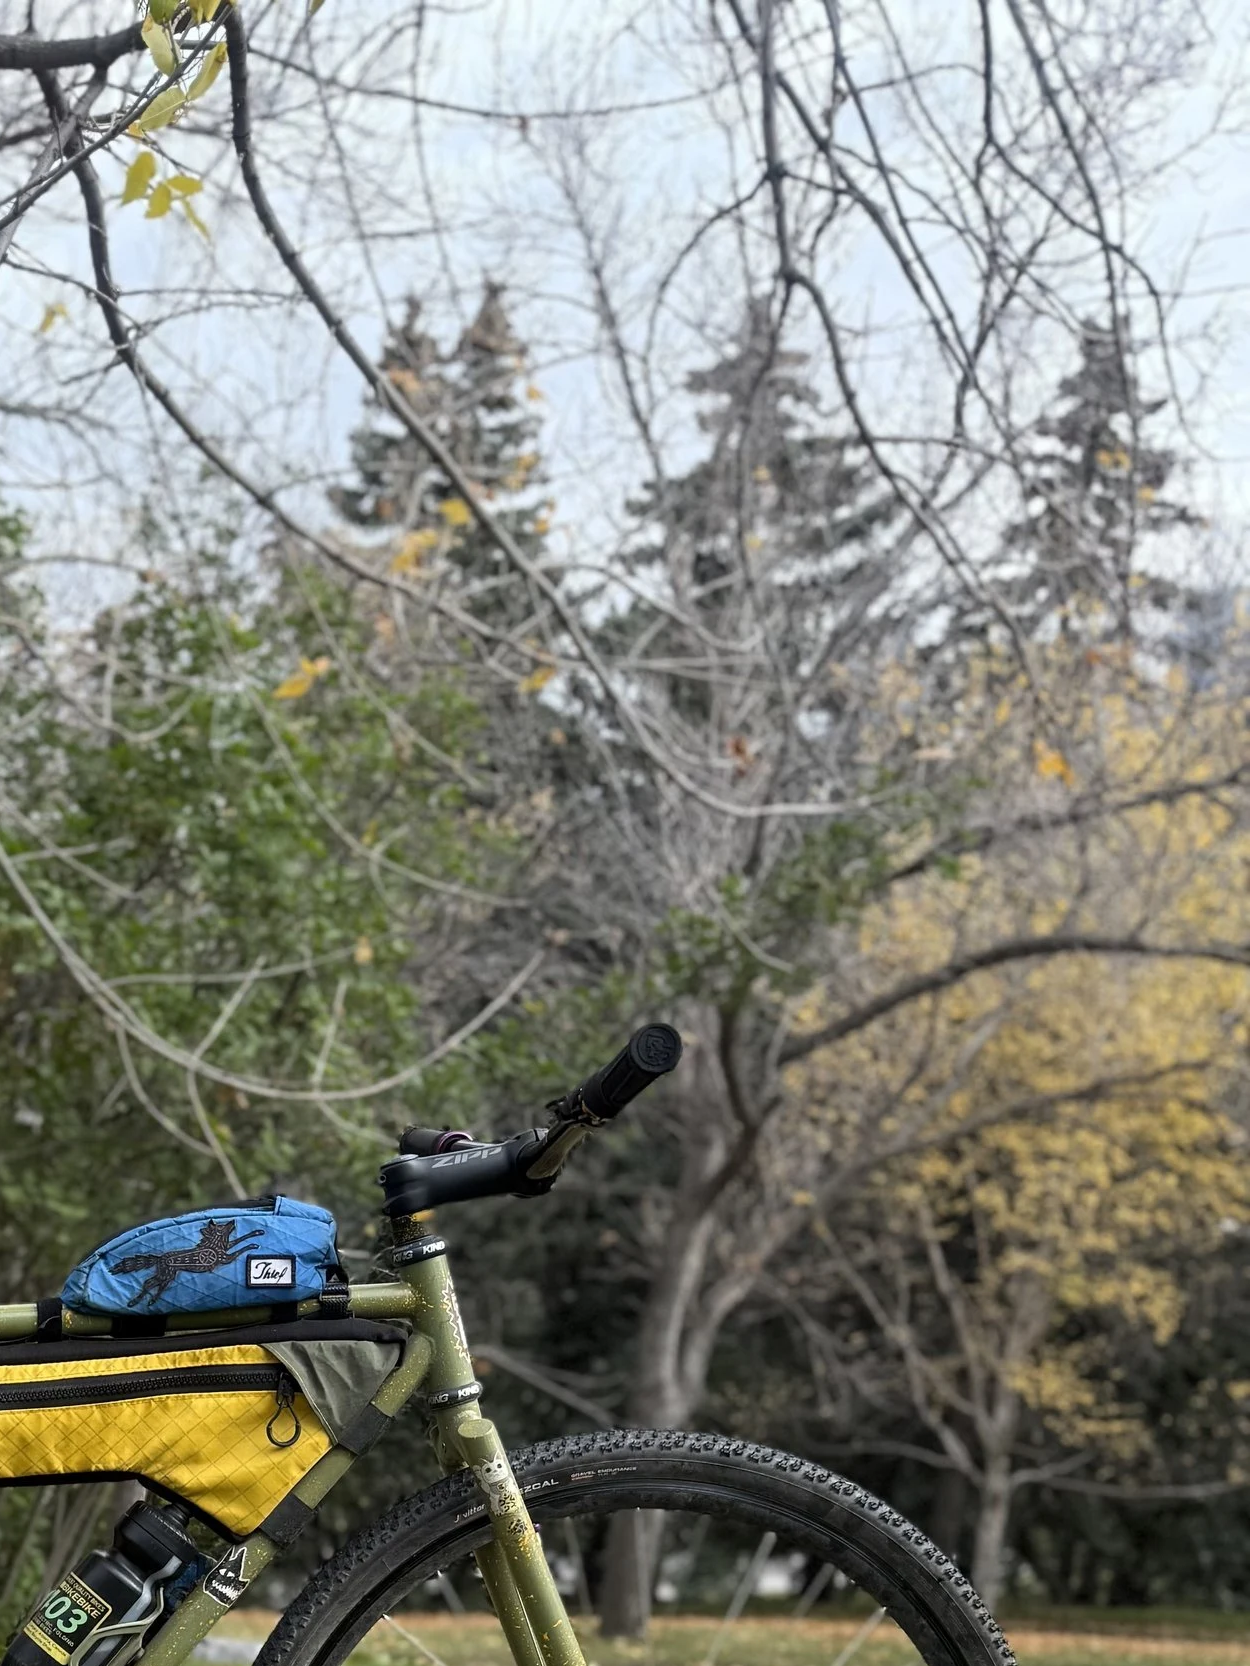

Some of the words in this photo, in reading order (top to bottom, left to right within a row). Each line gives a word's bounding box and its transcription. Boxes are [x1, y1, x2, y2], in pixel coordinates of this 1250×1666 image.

[431, 1146, 502, 1168] ZIPP
[462, 1503, 486, 1518] vittor
[520, 1479, 559, 1494] ZCAL
[73, 1582, 93, 1600] QUALITY
